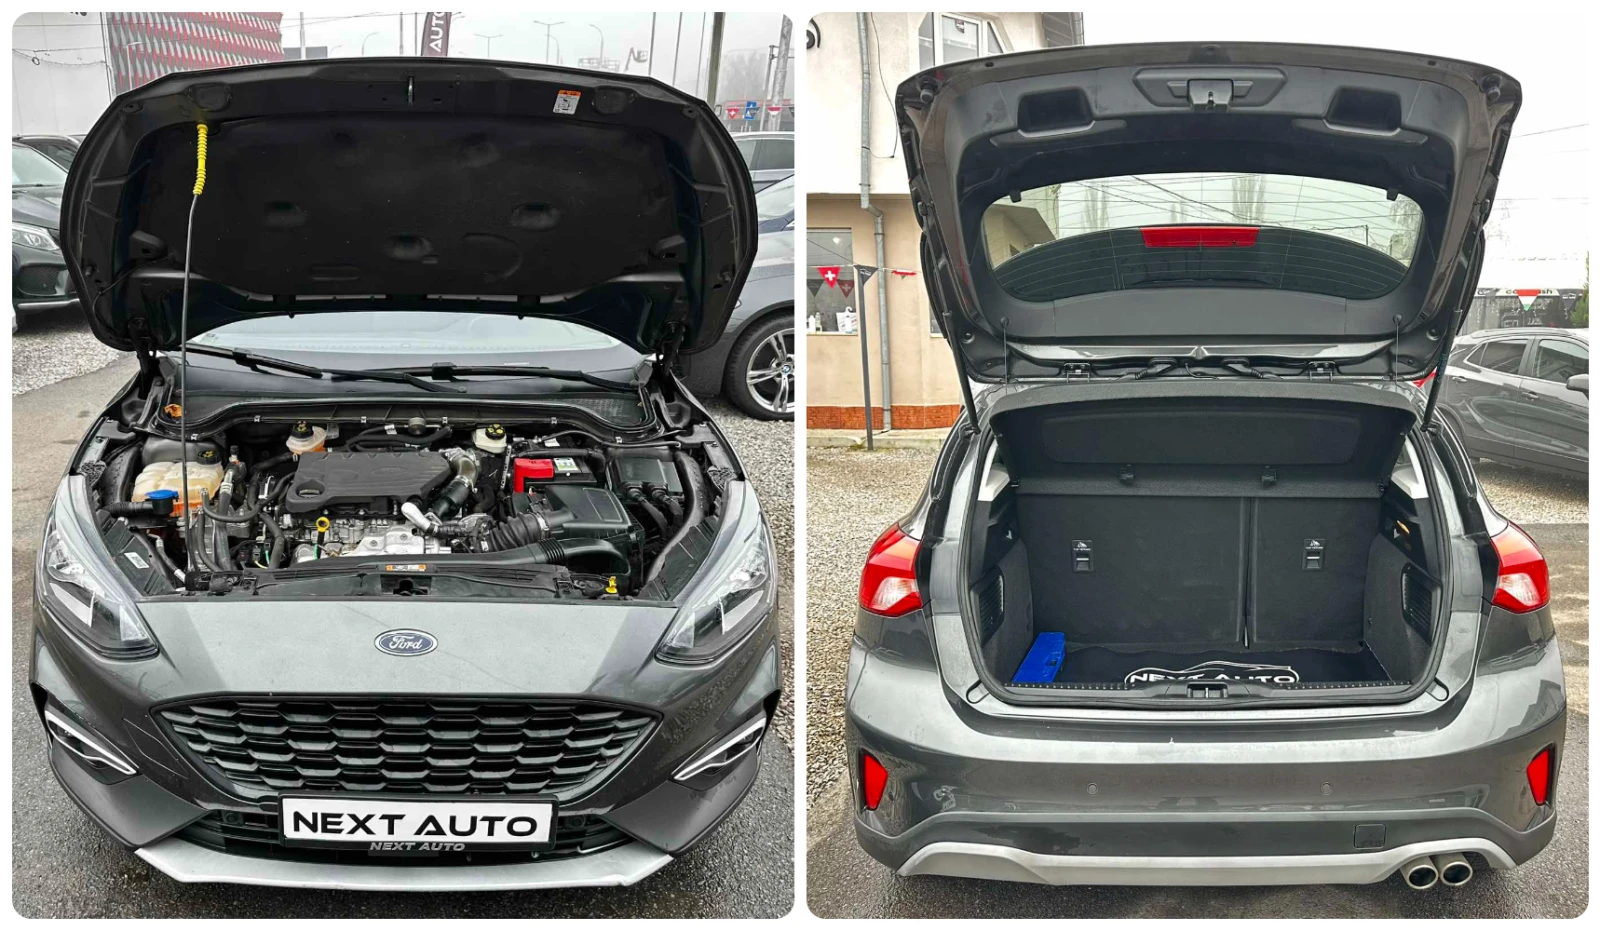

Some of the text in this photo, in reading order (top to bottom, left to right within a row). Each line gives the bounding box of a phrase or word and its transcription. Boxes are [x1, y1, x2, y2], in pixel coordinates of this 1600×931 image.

[389, 635, 422, 649] Ford
[293, 811, 538, 837] NEXT AUTO
[369, 842, 465, 852] NEXT AUTO
